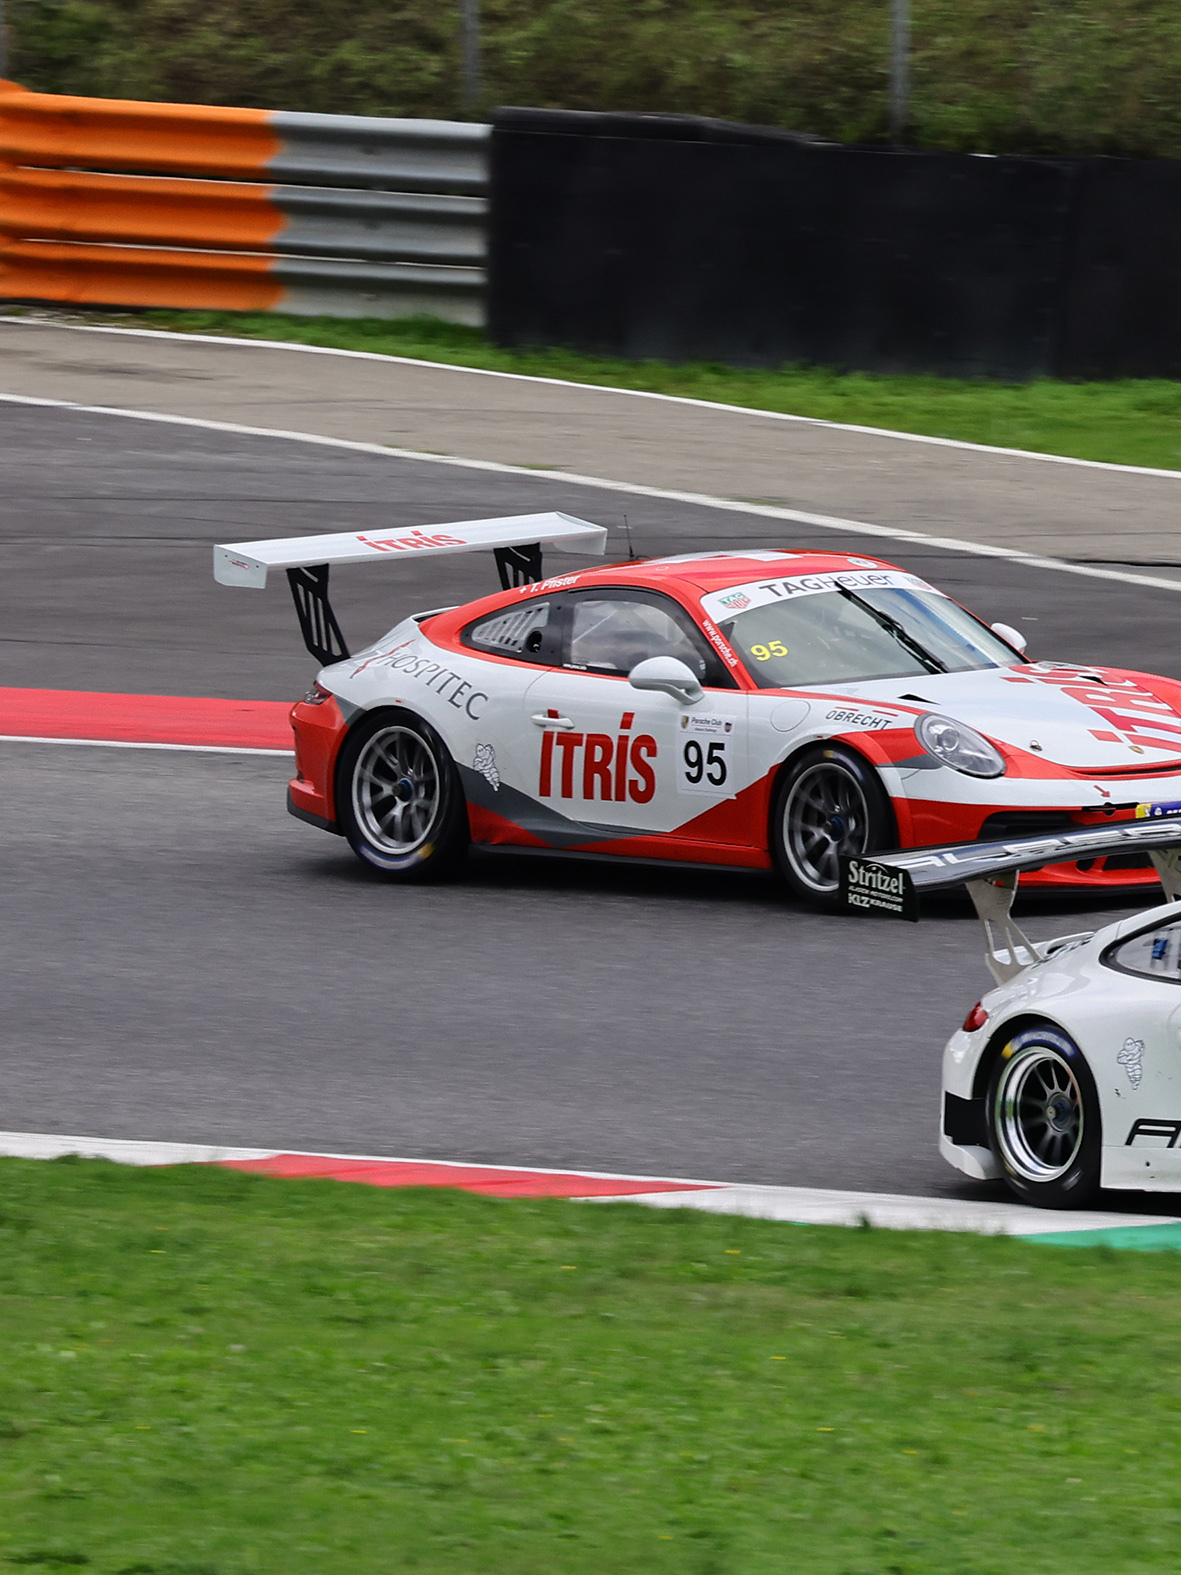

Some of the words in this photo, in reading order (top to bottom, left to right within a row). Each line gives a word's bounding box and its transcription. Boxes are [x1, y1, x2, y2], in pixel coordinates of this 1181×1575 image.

[751, 640, 789, 661] 95
[375, 651, 489, 721] HOSPITEC
[825, 710, 893, 731] OBRECHT
[684, 740, 727, 786] 95
[848, 860, 904, 895] Stritzel
